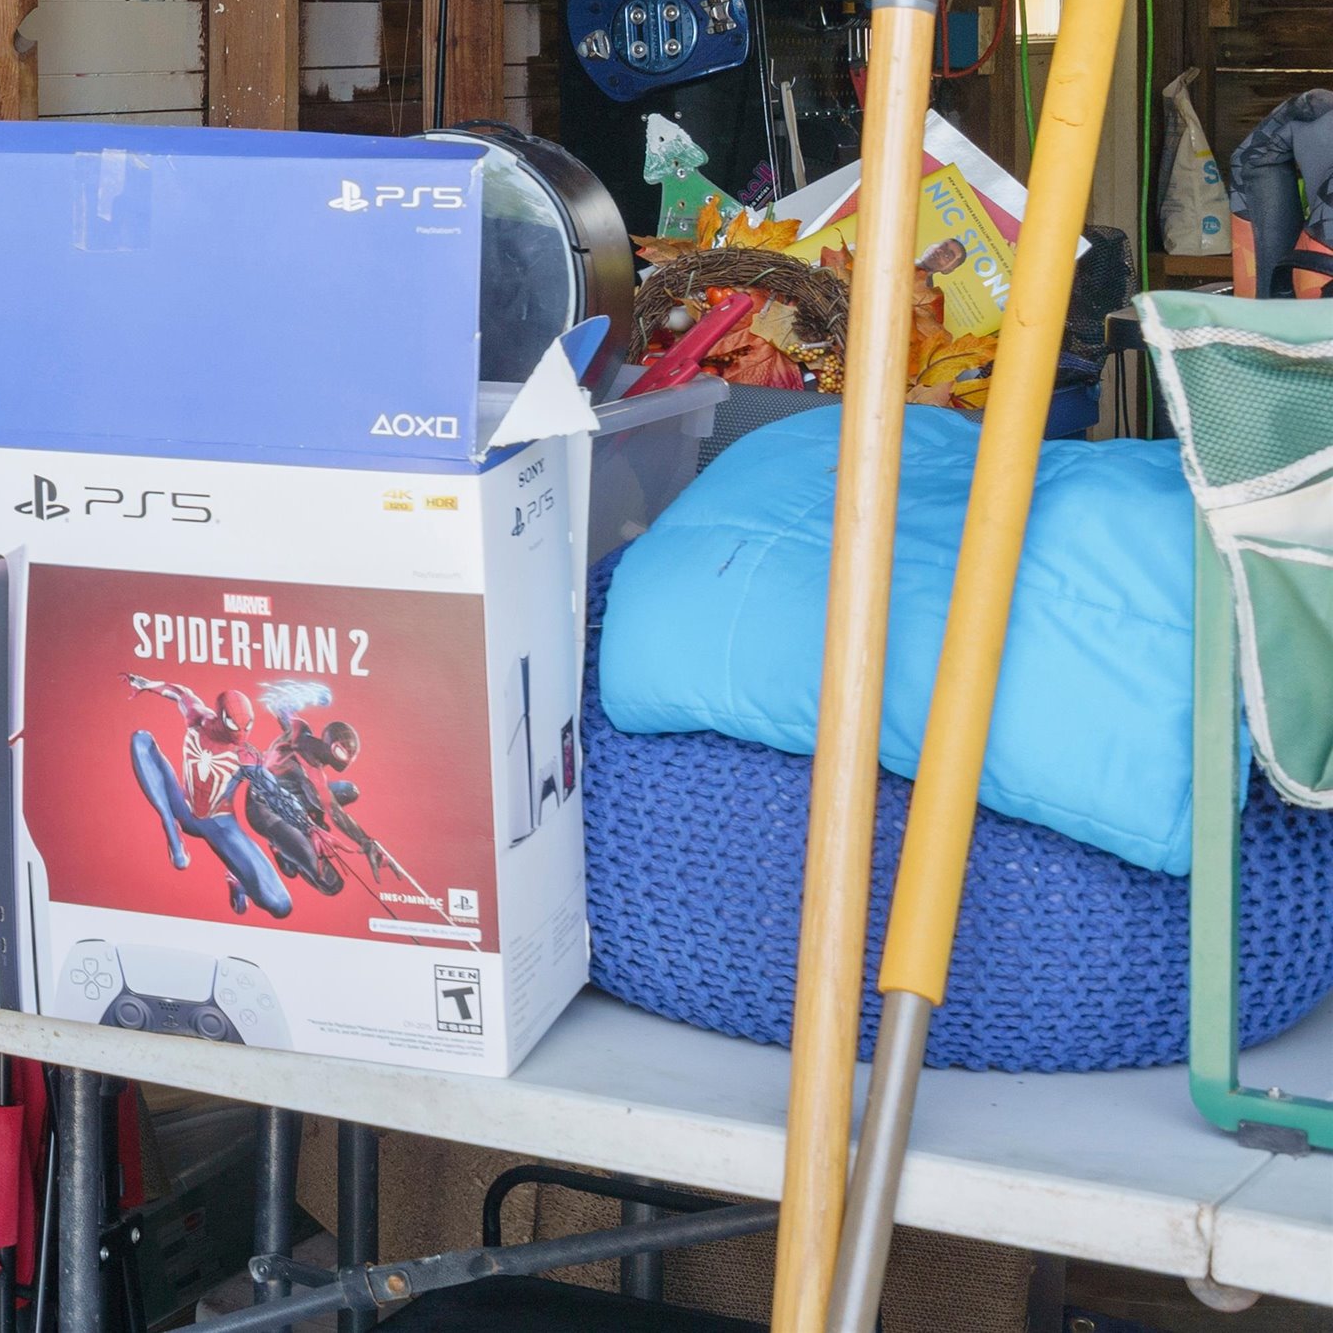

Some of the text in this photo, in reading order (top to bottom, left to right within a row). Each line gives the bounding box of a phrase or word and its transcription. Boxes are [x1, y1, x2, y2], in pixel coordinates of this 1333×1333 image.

[375, 186, 463, 208] PS5
[924, 181, 966, 226] NIC
[518, 458, 545, 488] SONY
[84, 486, 212, 523] PS5
[382, 488, 413, 500] 4K
[425, 497, 456, 510] HDR
[527, 488, 555, 524] PS5
[224, 593, 271, 616] MARVEL
[133, 612, 370, 677] SPIDER-MAN 2
[379, 892, 444, 908] INSOMNIAC
[438, 969, 477, 979] TEEN
[442, 986, 474, 1021] T
[438, 1022, 482, 1034] ESRB
